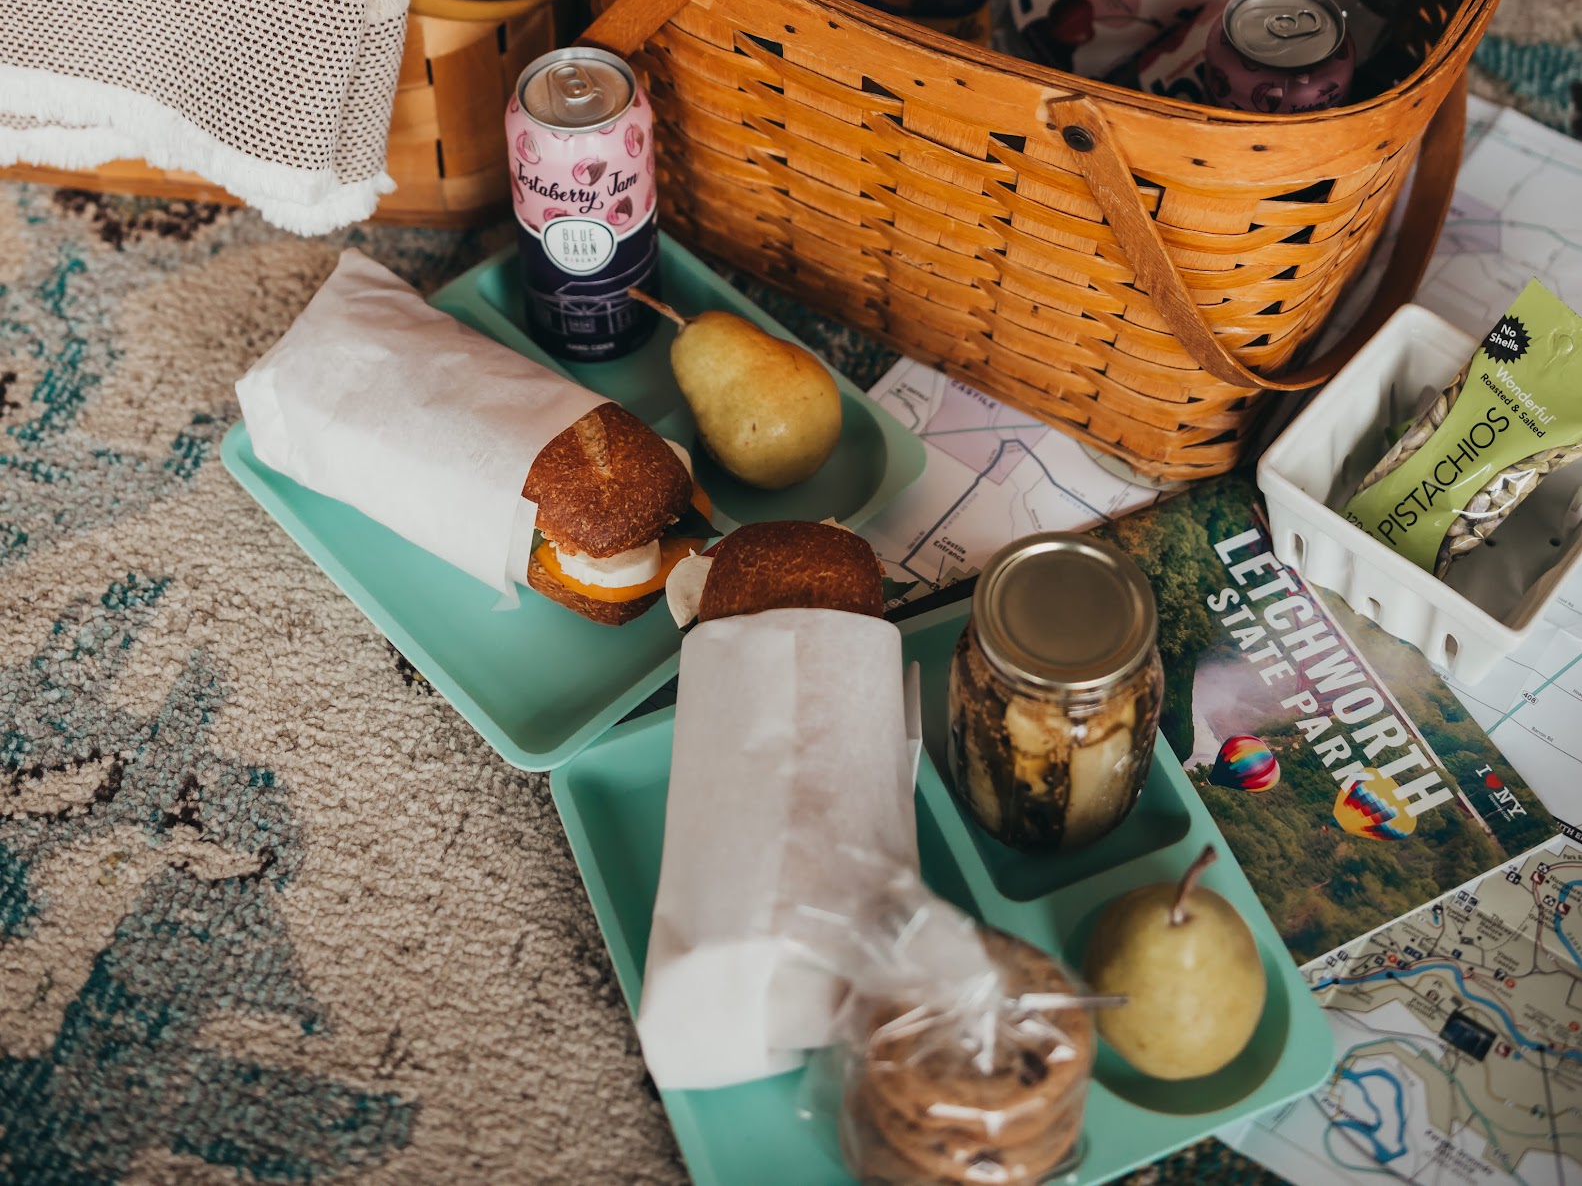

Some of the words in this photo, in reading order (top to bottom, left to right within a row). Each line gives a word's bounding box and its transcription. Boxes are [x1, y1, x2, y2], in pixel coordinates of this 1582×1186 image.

[515, 158, 604, 214] Jostaberry
[607, 170, 639, 197] Jam
[562, 227, 595, 242] BLUE
[563, 242, 598, 256] BARN
[1500, 323, 1517, 339] No
[1489, 332, 1520, 352] Shells
[1479, 372, 1512, 407] Roasted
[1510, 403, 1520, 414] &
[1518, 410, 1547, 439] Salted
[1377, 406, 1511, 546] PISTACHIOS
[932, 540, 966, 563] Entrance
[941, 536, 967, 555] Castile
[1214, 527, 1455, 819] LETCHWORTH
[1206, 587, 1296, 687] STATE
[1280, 690, 1376, 793] PARK
[1522, 692, 1537, 704] 408
[1546, 734, 1555, 743] Rd
[1475, 764, 1491, 778] I
[1493, 786, 1527, 818] NY
